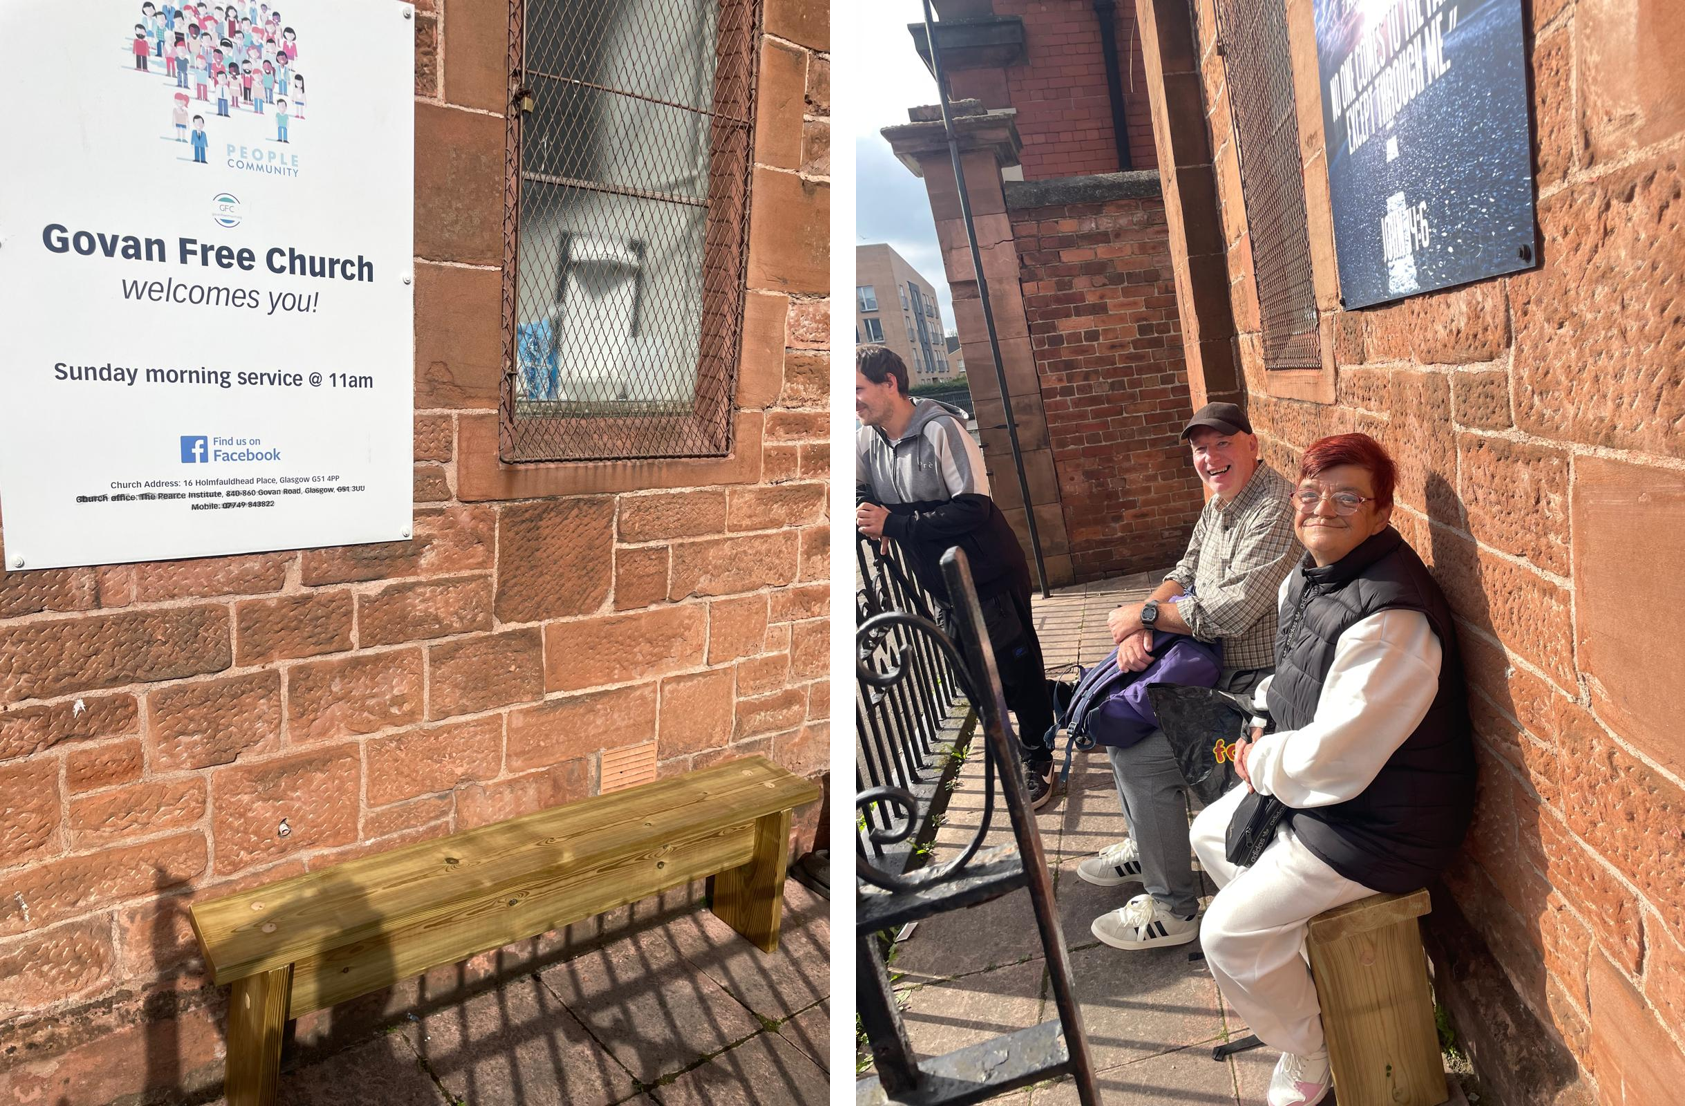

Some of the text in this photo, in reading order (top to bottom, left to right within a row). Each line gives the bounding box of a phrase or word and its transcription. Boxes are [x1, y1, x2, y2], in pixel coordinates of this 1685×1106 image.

[1330, 72, 1342, 123] NO
[1340, 52, 1357, 109] ONE
[1355, 22, 1387, 92] COMES
[1386, 4, 1402, 58] TO
[1346, 85, 1376, 156] EXCEPT
[1374, 33, 1425, 129] THROUGH
[226, 143, 299, 168] PEOPLE
[227, 158, 299, 178] COMMUNITY
[219, 204, 235, 213] GFC
[42, 223, 374, 283] Govan Free Church
[121, 277, 319, 316] welcomes you!
[54, 362, 374, 389] Sunday morning service @ 11am
[213, 436, 261, 446] Find us on
[214, 448, 281, 462] Facebook
[110, 479, 142, 489] Church
[144, 479, 181, 488] Address:
[183, 479, 193, 487] 16
[195, 477, 254, 487] Holmfauldhead
[256, 476, 278, 486] Place,
[279, 476, 310, 485] Glasgow
[312, 475, 325, 483] G51
[258, 488, 281, 497] Govan
[191, 502, 221, 511] Mobile:
[1250, 838, 1266, 863] adidas
